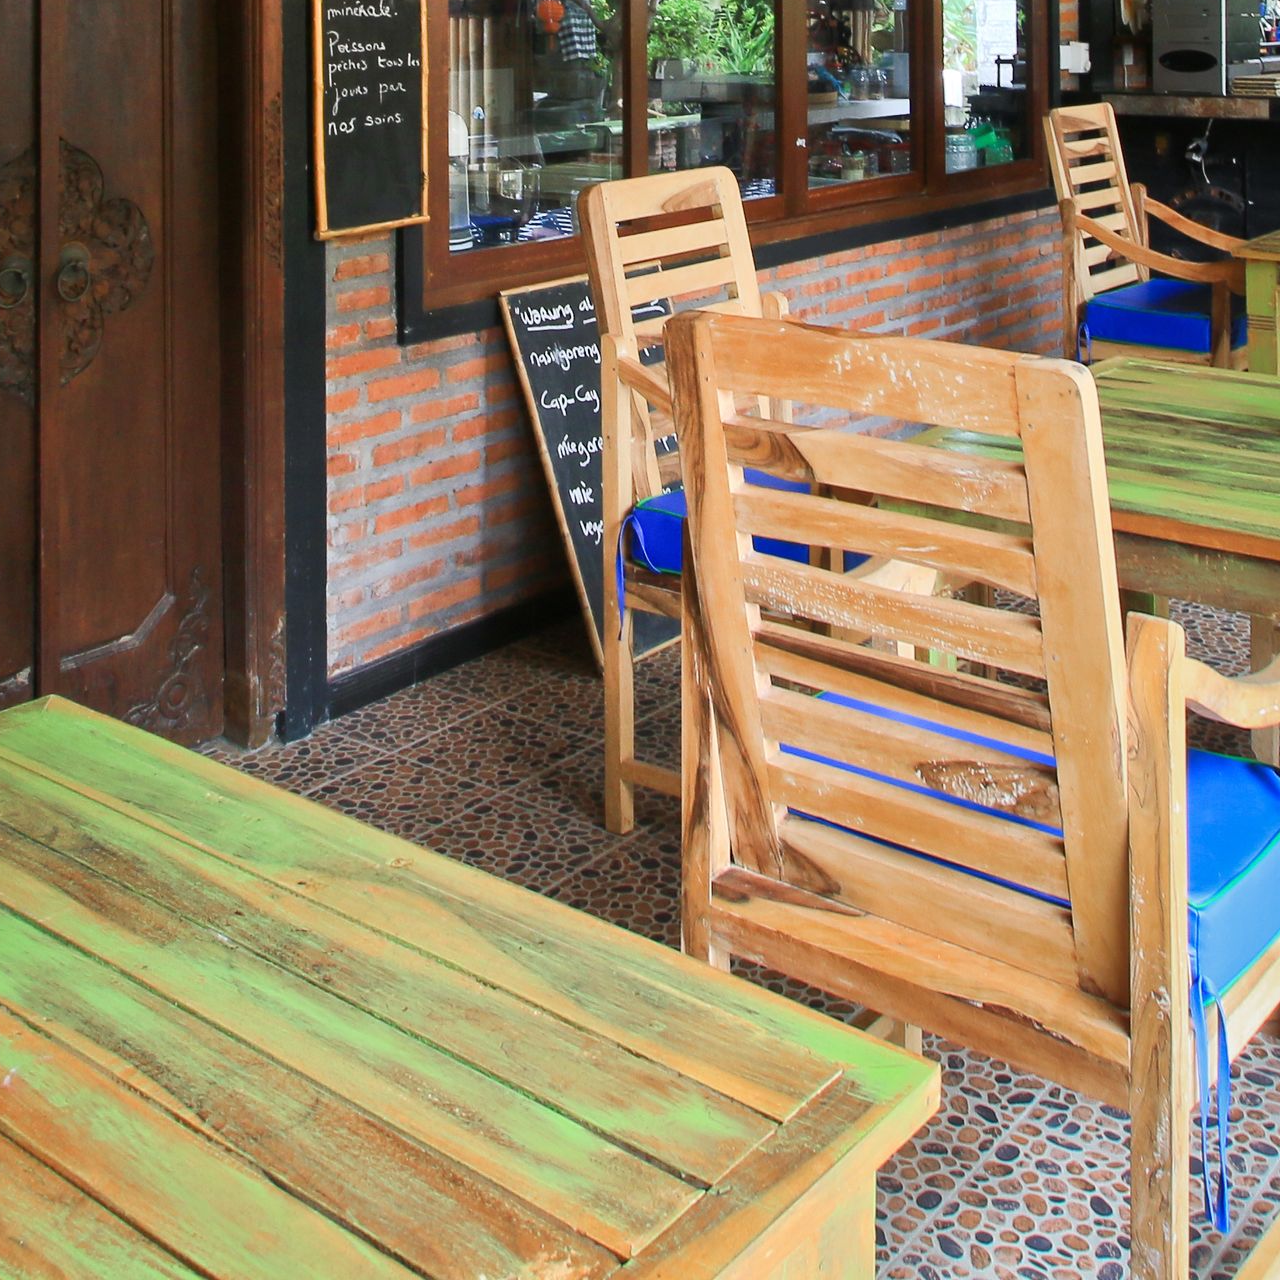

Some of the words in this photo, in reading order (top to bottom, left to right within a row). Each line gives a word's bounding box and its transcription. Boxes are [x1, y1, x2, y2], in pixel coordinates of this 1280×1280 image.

[327, 30, 386, 57] Poissons
[378, 56, 403, 68] tous
[331, 82, 368, 116] jours
[379, 82, 406, 104] par
[328, 117, 357, 135] nos
